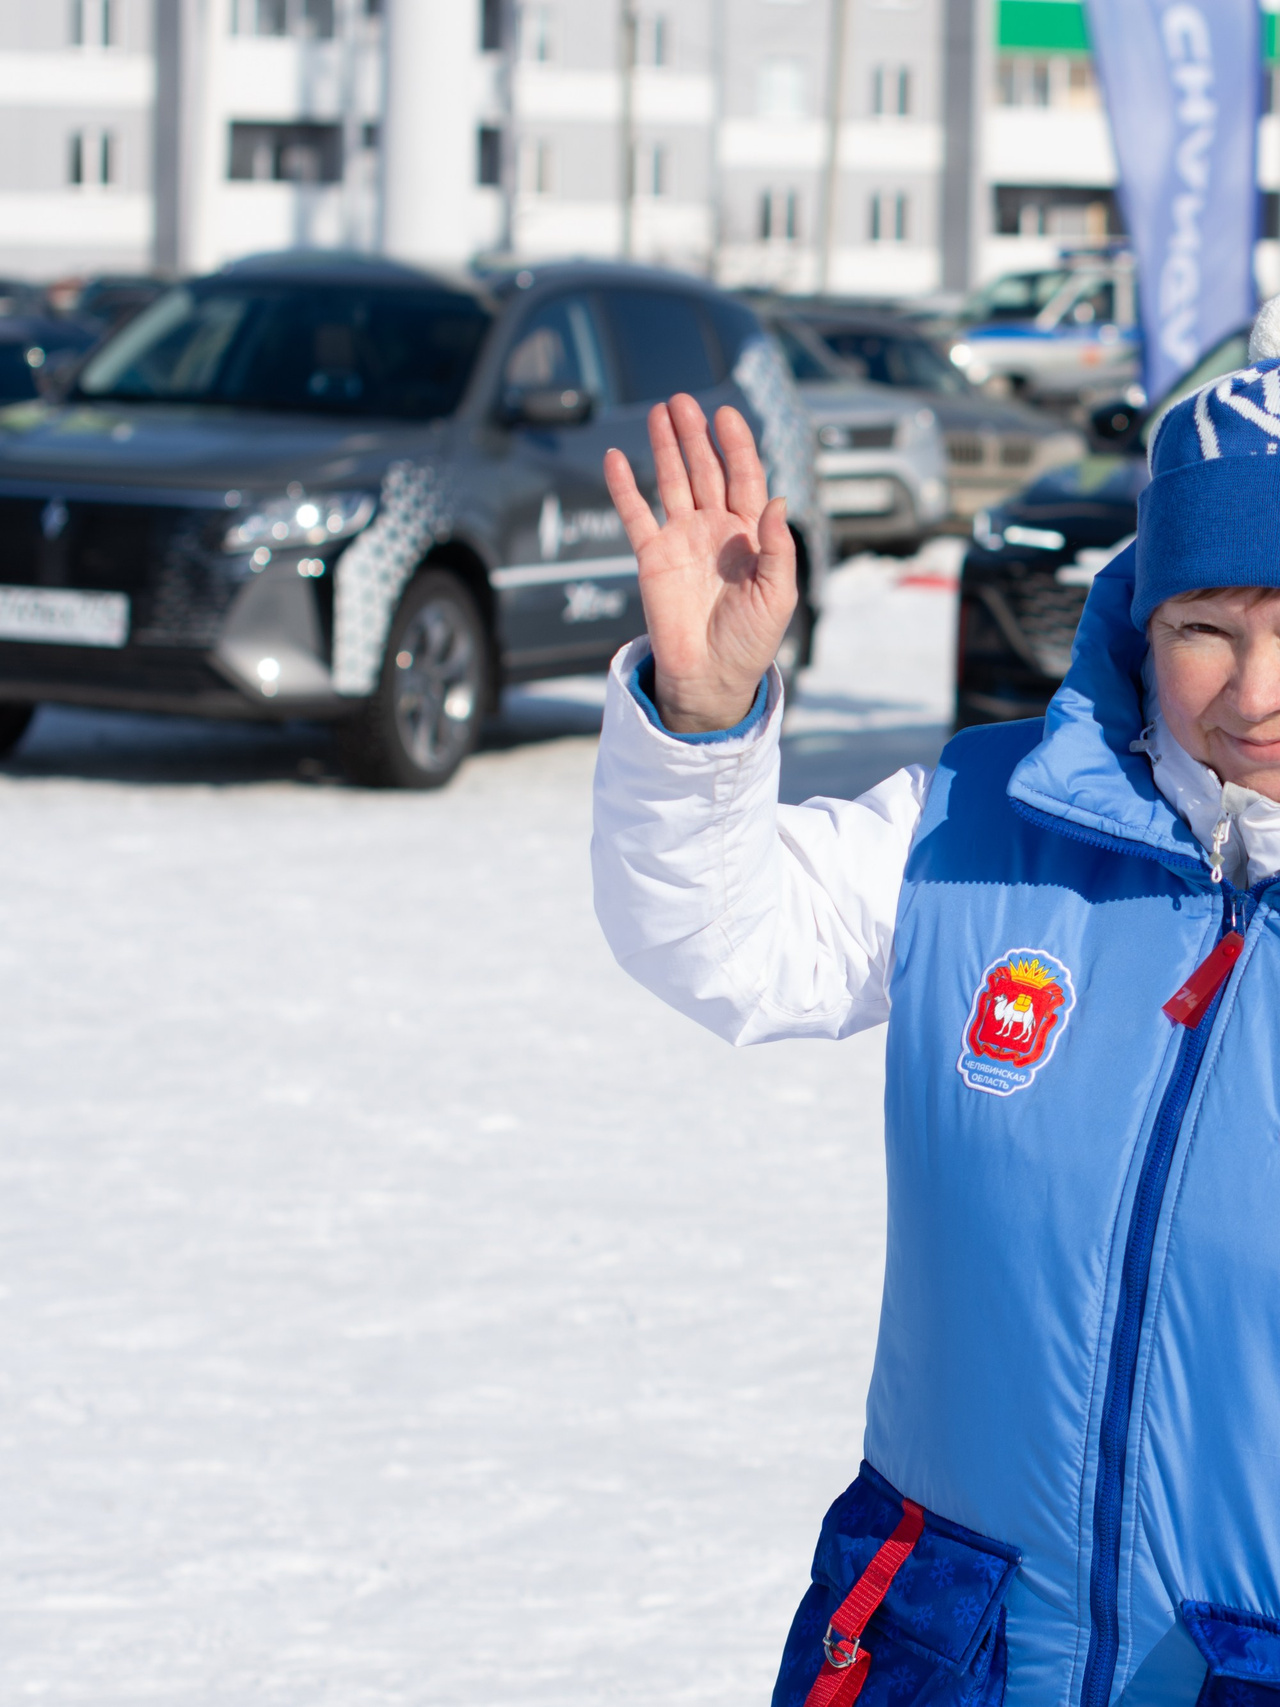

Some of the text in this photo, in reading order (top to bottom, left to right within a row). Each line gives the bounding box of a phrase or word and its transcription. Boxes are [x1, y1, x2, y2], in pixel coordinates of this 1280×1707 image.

[1175, 986, 1198, 1010] 74
[964, 1059, 1026, 1083] ЧЕЛЯБИНСКАЯ
[971, 1072, 1010, 1090] ОБЛАСТЬ
